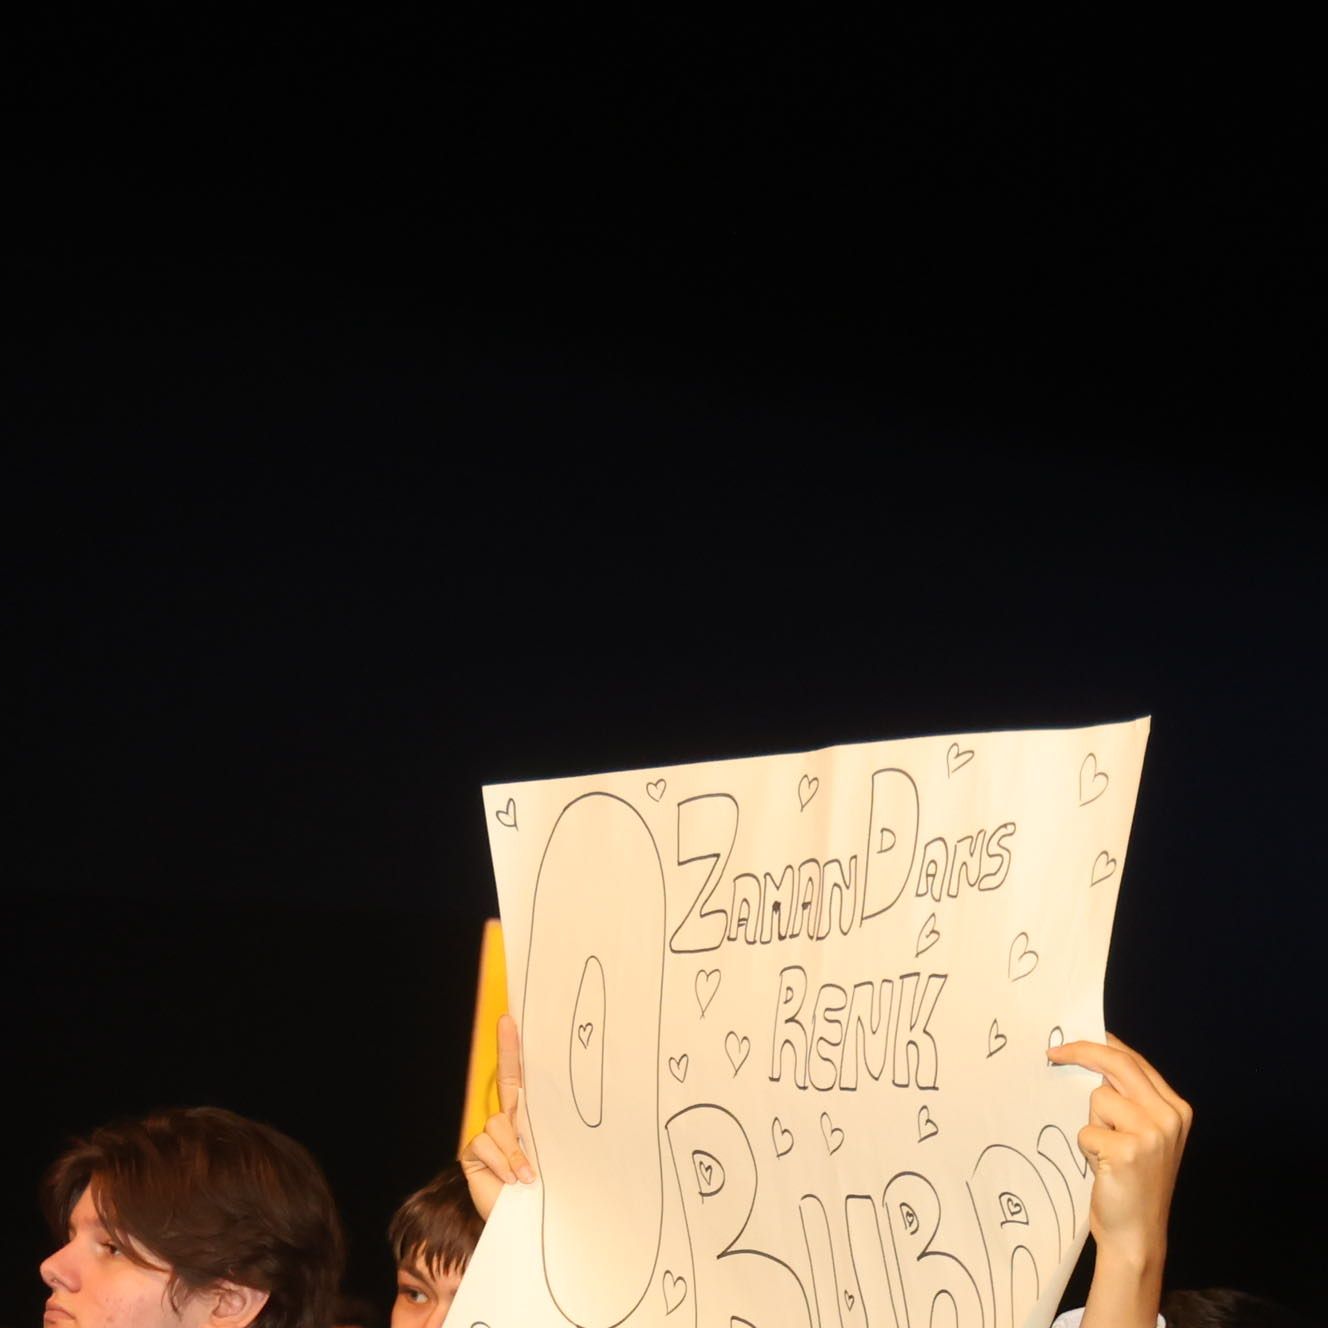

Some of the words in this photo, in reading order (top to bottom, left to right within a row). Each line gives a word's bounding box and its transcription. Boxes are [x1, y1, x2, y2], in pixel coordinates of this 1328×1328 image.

[669, 792, 858, 954] ZAMAN
[859, 767, 1016, 928] DANS
[768, 965, 948, 1091] RENK
